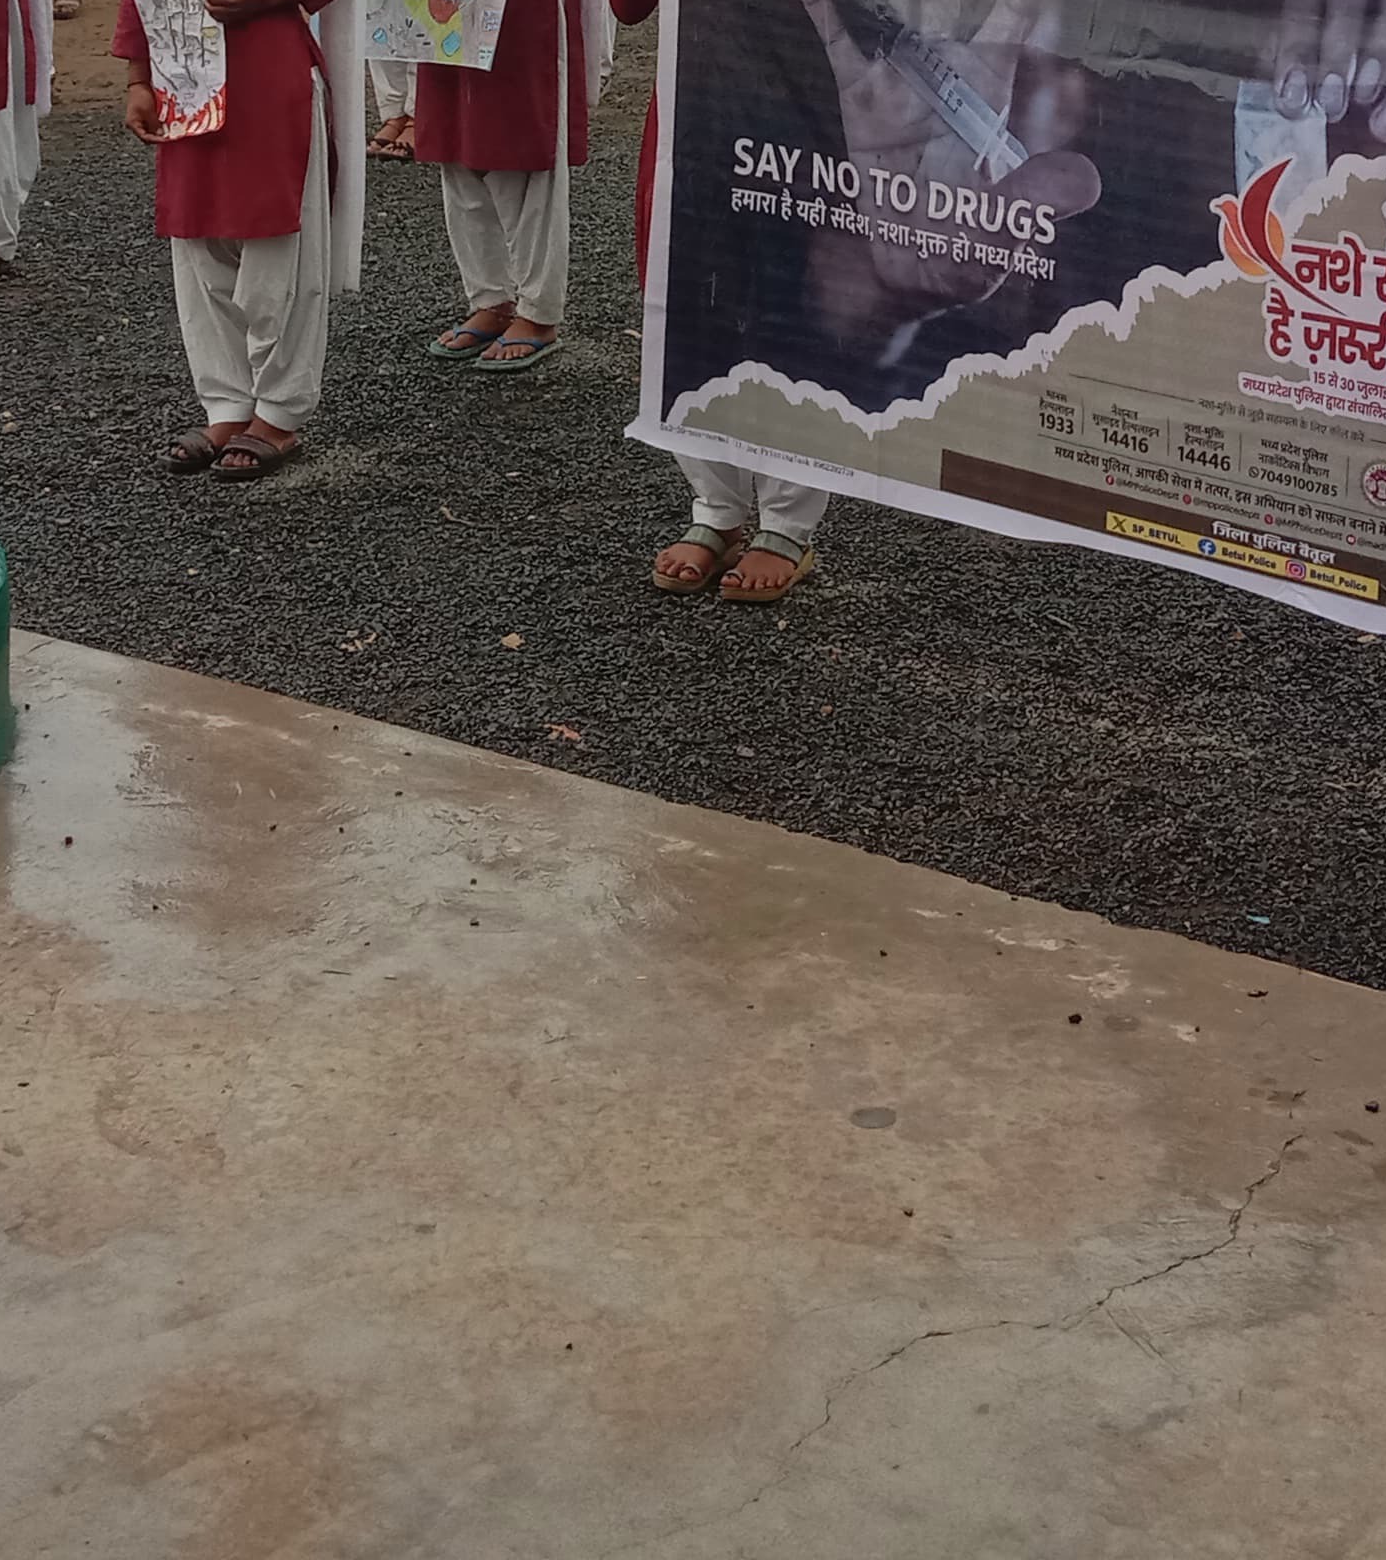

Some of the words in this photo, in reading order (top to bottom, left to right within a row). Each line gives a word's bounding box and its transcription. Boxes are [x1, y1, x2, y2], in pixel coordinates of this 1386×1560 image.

[733, 138, 802, 184] SAY
[813, 152, 860, 198] NO
[868, 167, 917, 212] TO
[928, 181, 1056, 244] DRUGS
[731, 187, 777, 215] हमारा
[781, 188, 793, 221] है
[797, 200, 826, 227] यही
[877, 219, 949, 259] नशा-मुक्त
[952, 232, 969, 261] हो
[974, 242, 1010, 269] मध्य
[1013, 247, 1056, 280] प्रदेश
[1292, 236, 1366, 297] नशे
[1267, 287, 1295, 357] है
[1243, 377, 1265, 393] मध्य
[1267, 381, 1291, 398] प्रदेश
[1294, 384, 1324, 407] पुलिस
[1326, 394, 1346, 414] द्वारा
[1314, 371, 1326, 385] 15
[1328, 372, 1339, 389] से
[1340, 377, 1355, 391] 30
[1038, 412, 1074, 436] 1933
[1102, 429, 1149, 454] 14416
[1177, 446, 1231, 472] 14446
[1054, 446, 1074, 461] मध्य
[1077, 450, 1099, 467] प्रदेश
[1135, 465, 1168, 484] आपकी
[1171, 472, 1193, 489] सेवा
[1235, 488, 1252, 506] इस
[1254, 492, 1296, 516] अभियान
[1298, 500, 1313, 520] को
[1350, 512, 1377, 536] बनाने
[1259, 469, 1338, 497] 7049100785
[1212, 520, 1250, 543] जिला
[1252, 529, 1296, 556] पुलिस
[1248, 553, 1277, 569] Police
